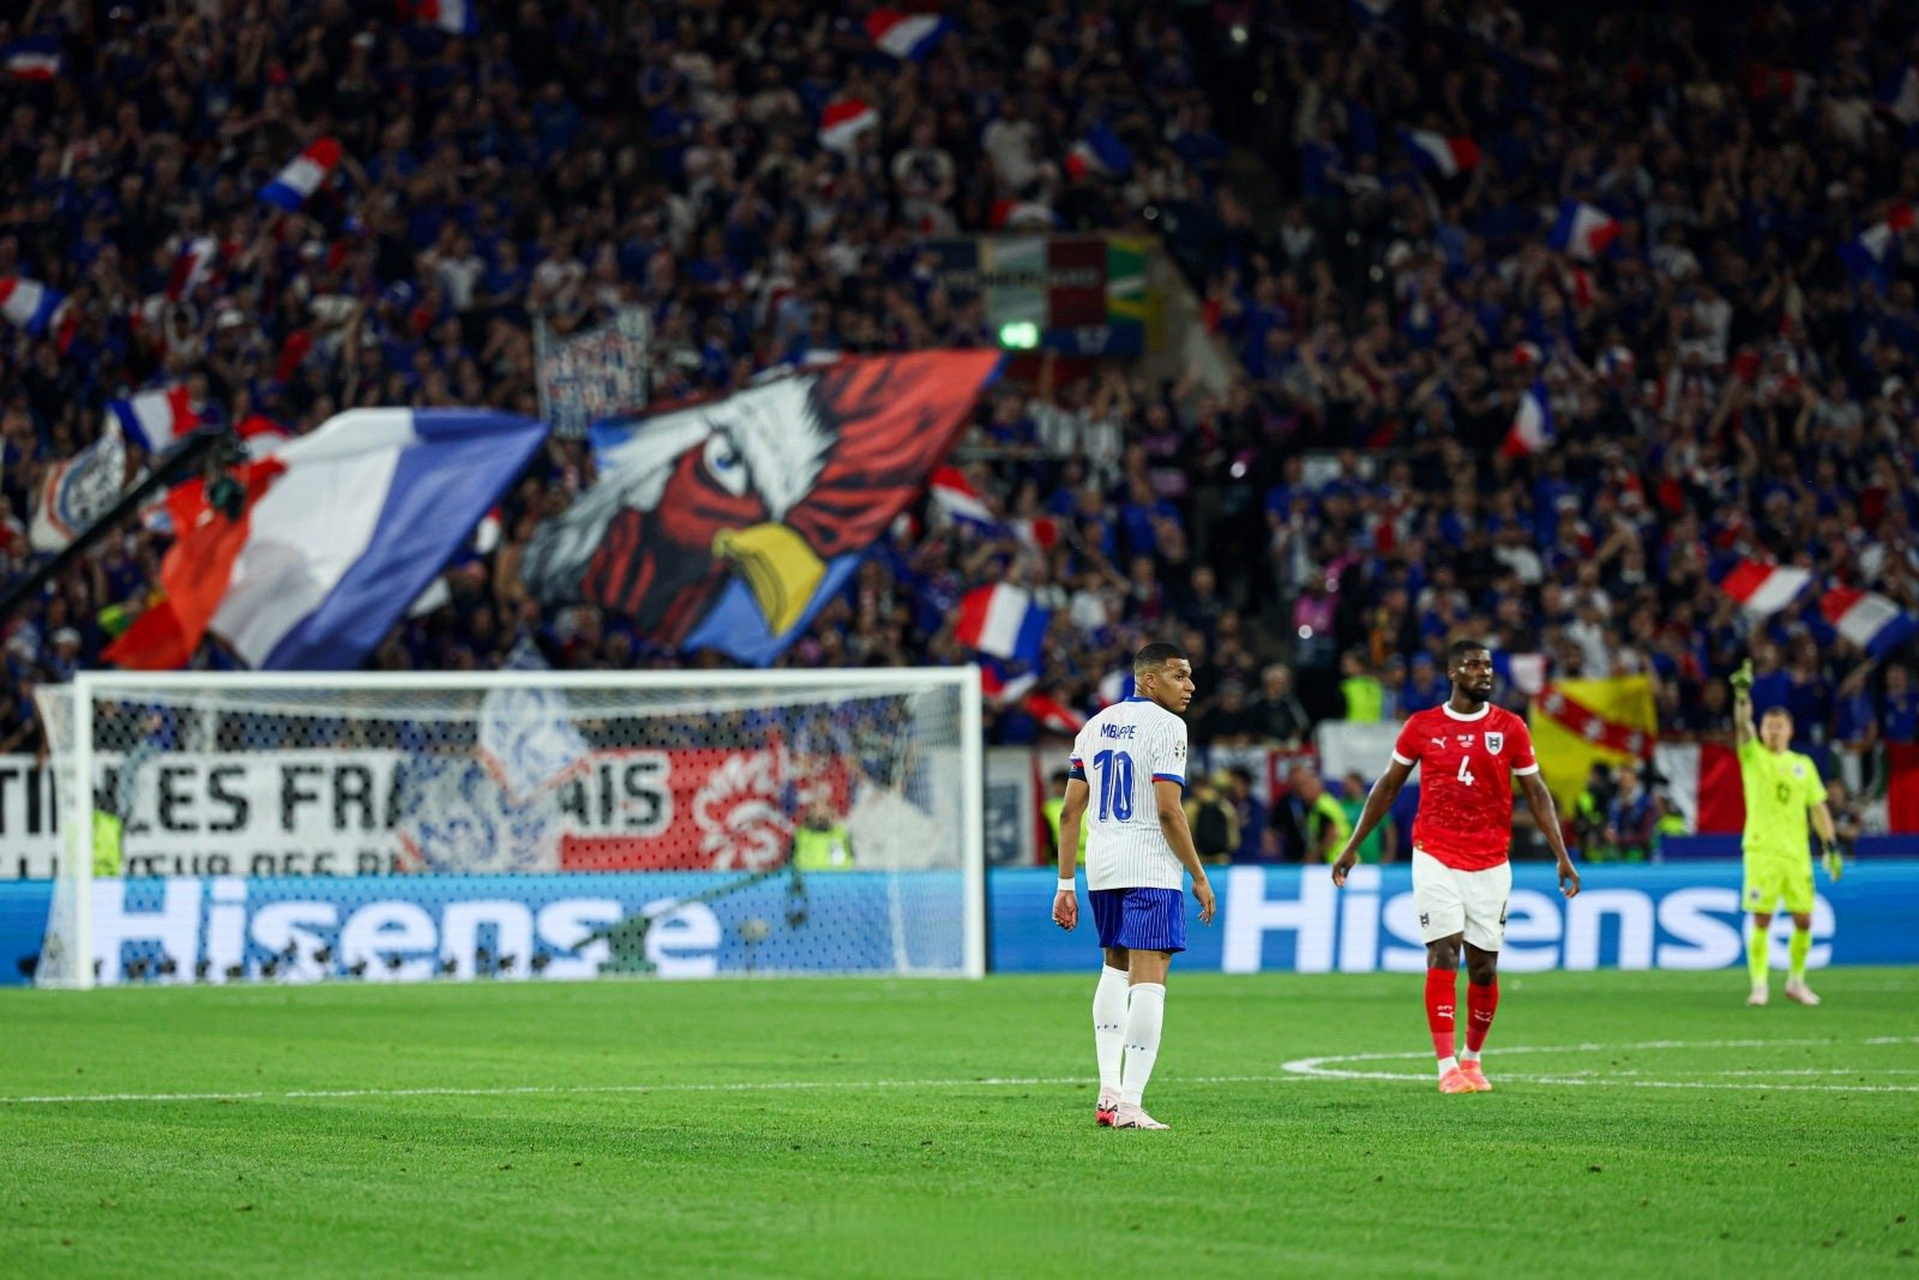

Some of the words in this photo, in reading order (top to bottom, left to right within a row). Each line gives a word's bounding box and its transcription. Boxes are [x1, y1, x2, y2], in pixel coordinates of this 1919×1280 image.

[1093, 749, 1135, 823] 10
[1457, 755, 1475, 786] 4
[90, 879, 721, 984] Hisense
